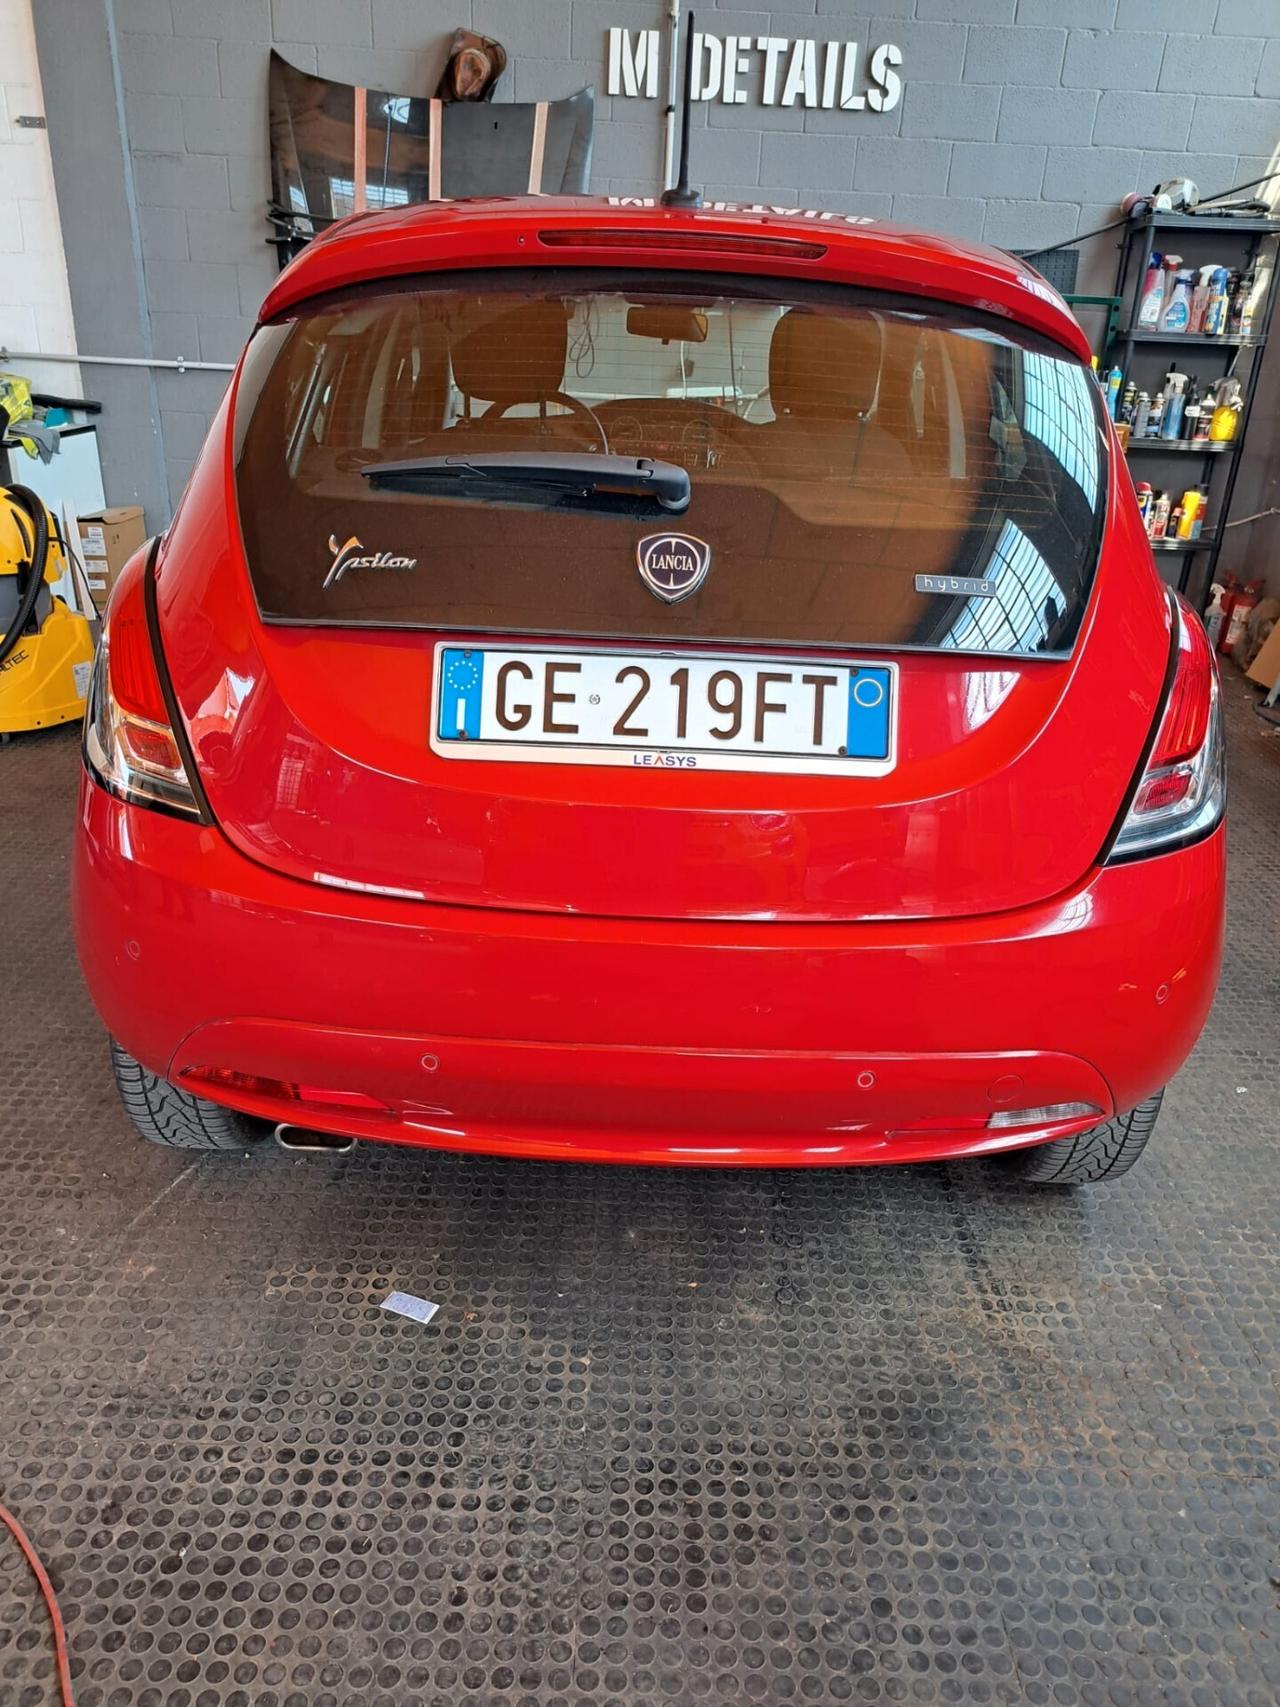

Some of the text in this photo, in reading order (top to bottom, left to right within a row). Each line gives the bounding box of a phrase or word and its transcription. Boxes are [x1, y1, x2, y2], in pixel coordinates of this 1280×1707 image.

[608, 27, 903, 113] M DETAILS
[322, 534, 418, 589] Ypsilon
[652, 553, 694, 572] LANCIA
[924, 576, 989, 592] hybrid
[495, 660, 838, 746] GE 219FT
[633, 754, 697, 767] LEASYS
